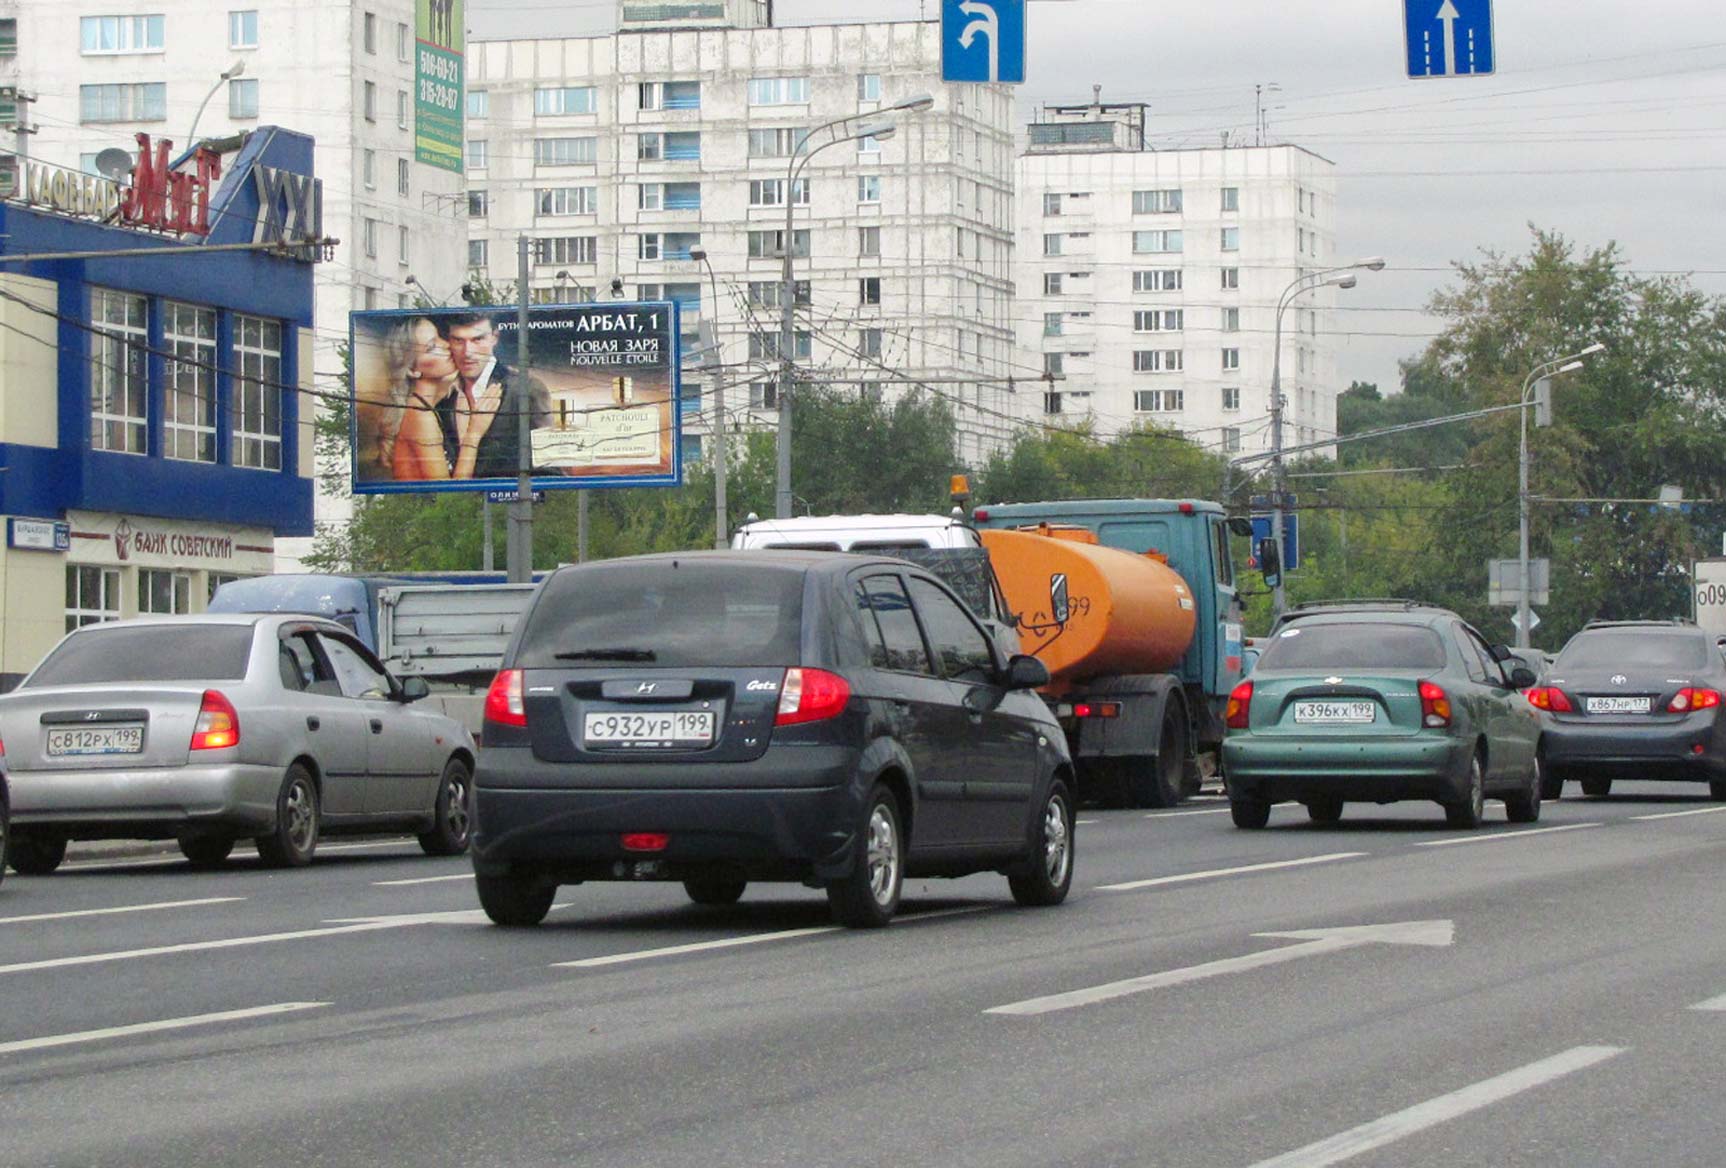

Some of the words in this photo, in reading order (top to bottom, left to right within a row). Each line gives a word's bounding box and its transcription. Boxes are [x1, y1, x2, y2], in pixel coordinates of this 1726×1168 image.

[498, 322, 520, 331] БУТИ
[528, 320, 574, 330] АРОМАТОВ
[576, 313, 643, 333] АРБАТ,
[650, 313, 658, 330] 1
[570, 340, 618, 353] НОВАЯ
[625, 338, 659, 352] ЗАРЯ
[570, 354, 622, 366] NOUVELLE
[134, 531, 168, 554] БАНК
[171, 534, 233, 559] СОВЕТСКИЙ
[746, 680, 777, 690] Getz
[1352, 703, 1371, 714] 199
[678, 714, 708, 730] 199
[116, 730, 138, 742] 199
